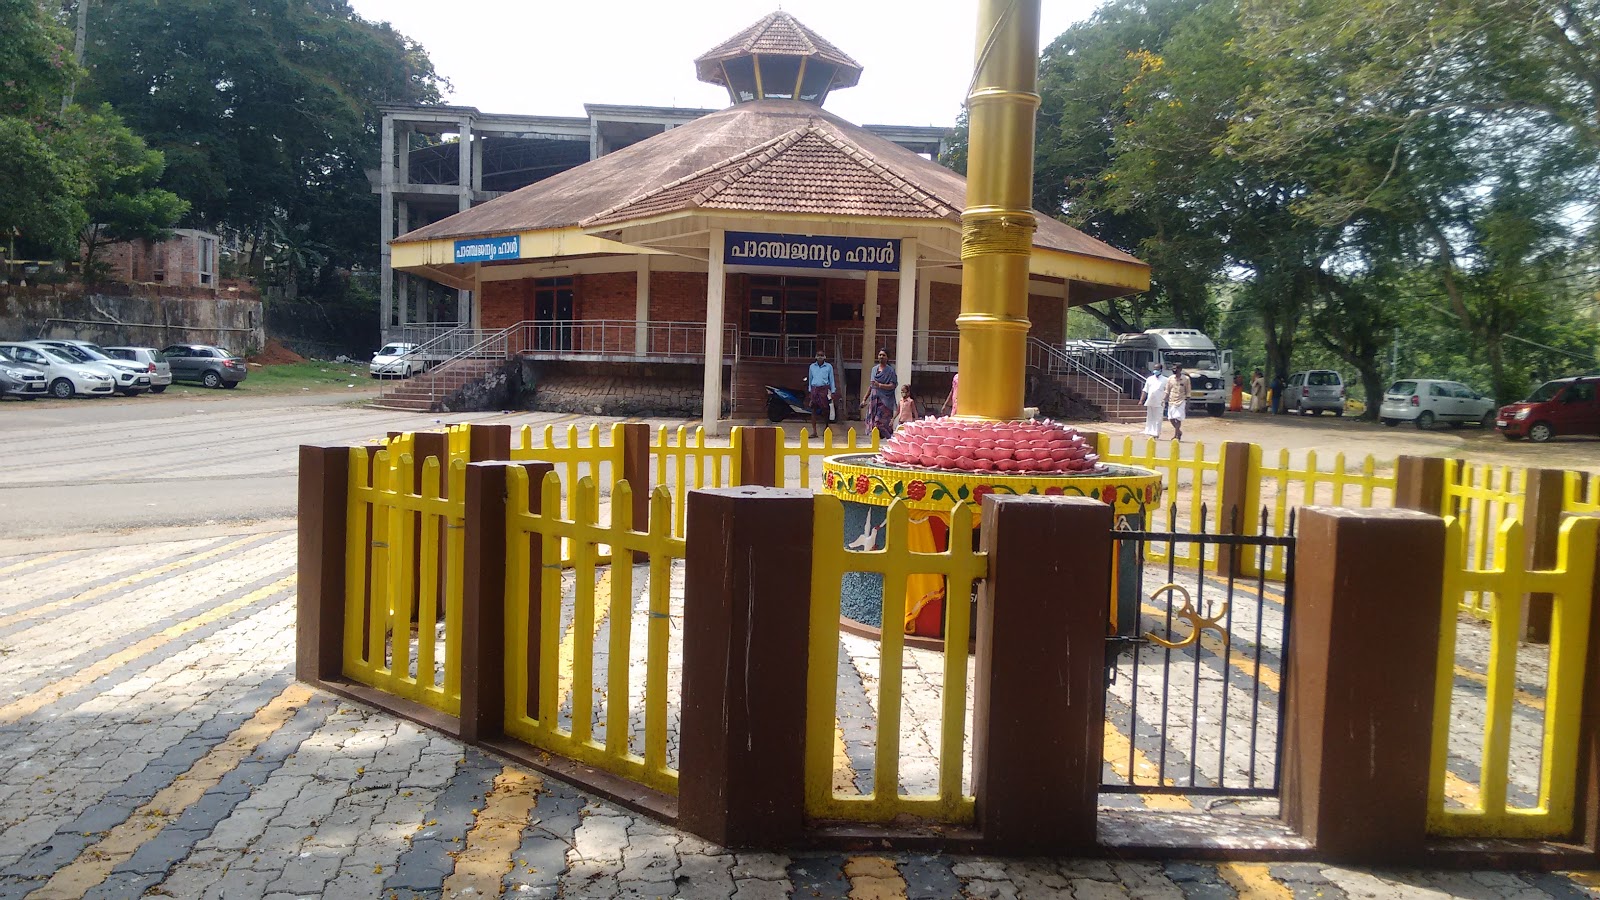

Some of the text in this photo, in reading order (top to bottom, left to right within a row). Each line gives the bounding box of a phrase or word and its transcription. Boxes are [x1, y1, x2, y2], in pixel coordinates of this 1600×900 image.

[456, 237, 518, 260] പാഞ്ചജന്യം ഹാൾ
[731, 240, 895, 268] പാഞ്ചജന്യം ഹാൾ
